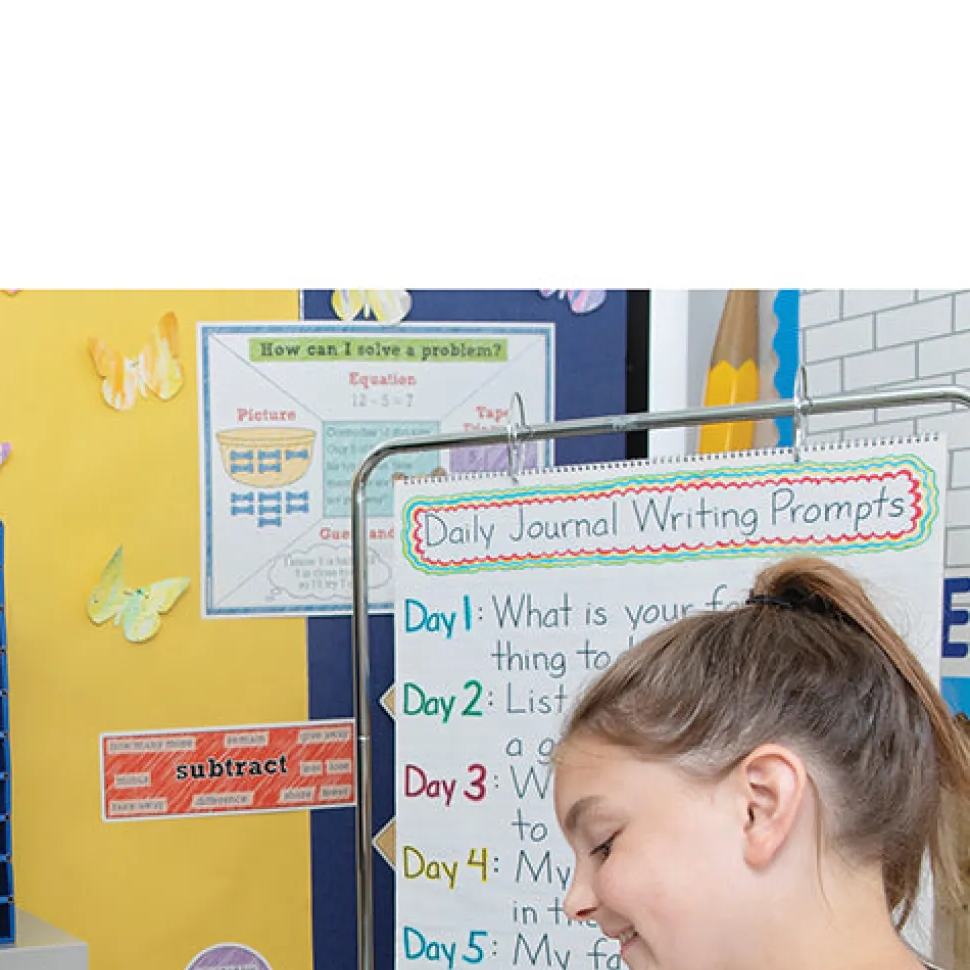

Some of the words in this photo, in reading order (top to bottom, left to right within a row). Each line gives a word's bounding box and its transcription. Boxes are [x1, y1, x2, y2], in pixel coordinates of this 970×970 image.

[260, 342, 303, 357] How
[308, 344, 339, 357] can
[343, 342, 352, 356] I
[358, 341, 401, 356] solve
[406, 345, 415, 356] a
[421, 340, 502, 361] problem?
[349, 372, 417, 388] Equation
[352, 394, 367, 407] 12
[382, 394, 390, 407] 5
[406, 393, 414, 407] 7
[237, 408, 297, 423] Picture
[424, 513, 495, 548] Daily
[509, 506, 617, 541] Journal
[630, 497, 758, 536] Writing
[771, 486, 905, 534] Prompts
[319, 527, 351, 541] Gue
[404, 598, 457, 639] Day
[492, 592, 572, 629] What
[585, 602, 608, 626] is
[624, 603, 694, 630] your
[492, 640, 567, 678] thing
[576, 639, 611, 670] to
[403, 682, 456, 723] Day
[506, 682, 568, 714] List
[506, 737, 522, 757] a
[176, 755, 287, 781] subtract
[404, 764, 456, 806] Day
[510, 808, 548, 842] to
[403, 845, 458, 889] Day
[515, 849, 571, 891] My
[513, 900, 537, 925] in
[403, 926, 456, 970] Day
